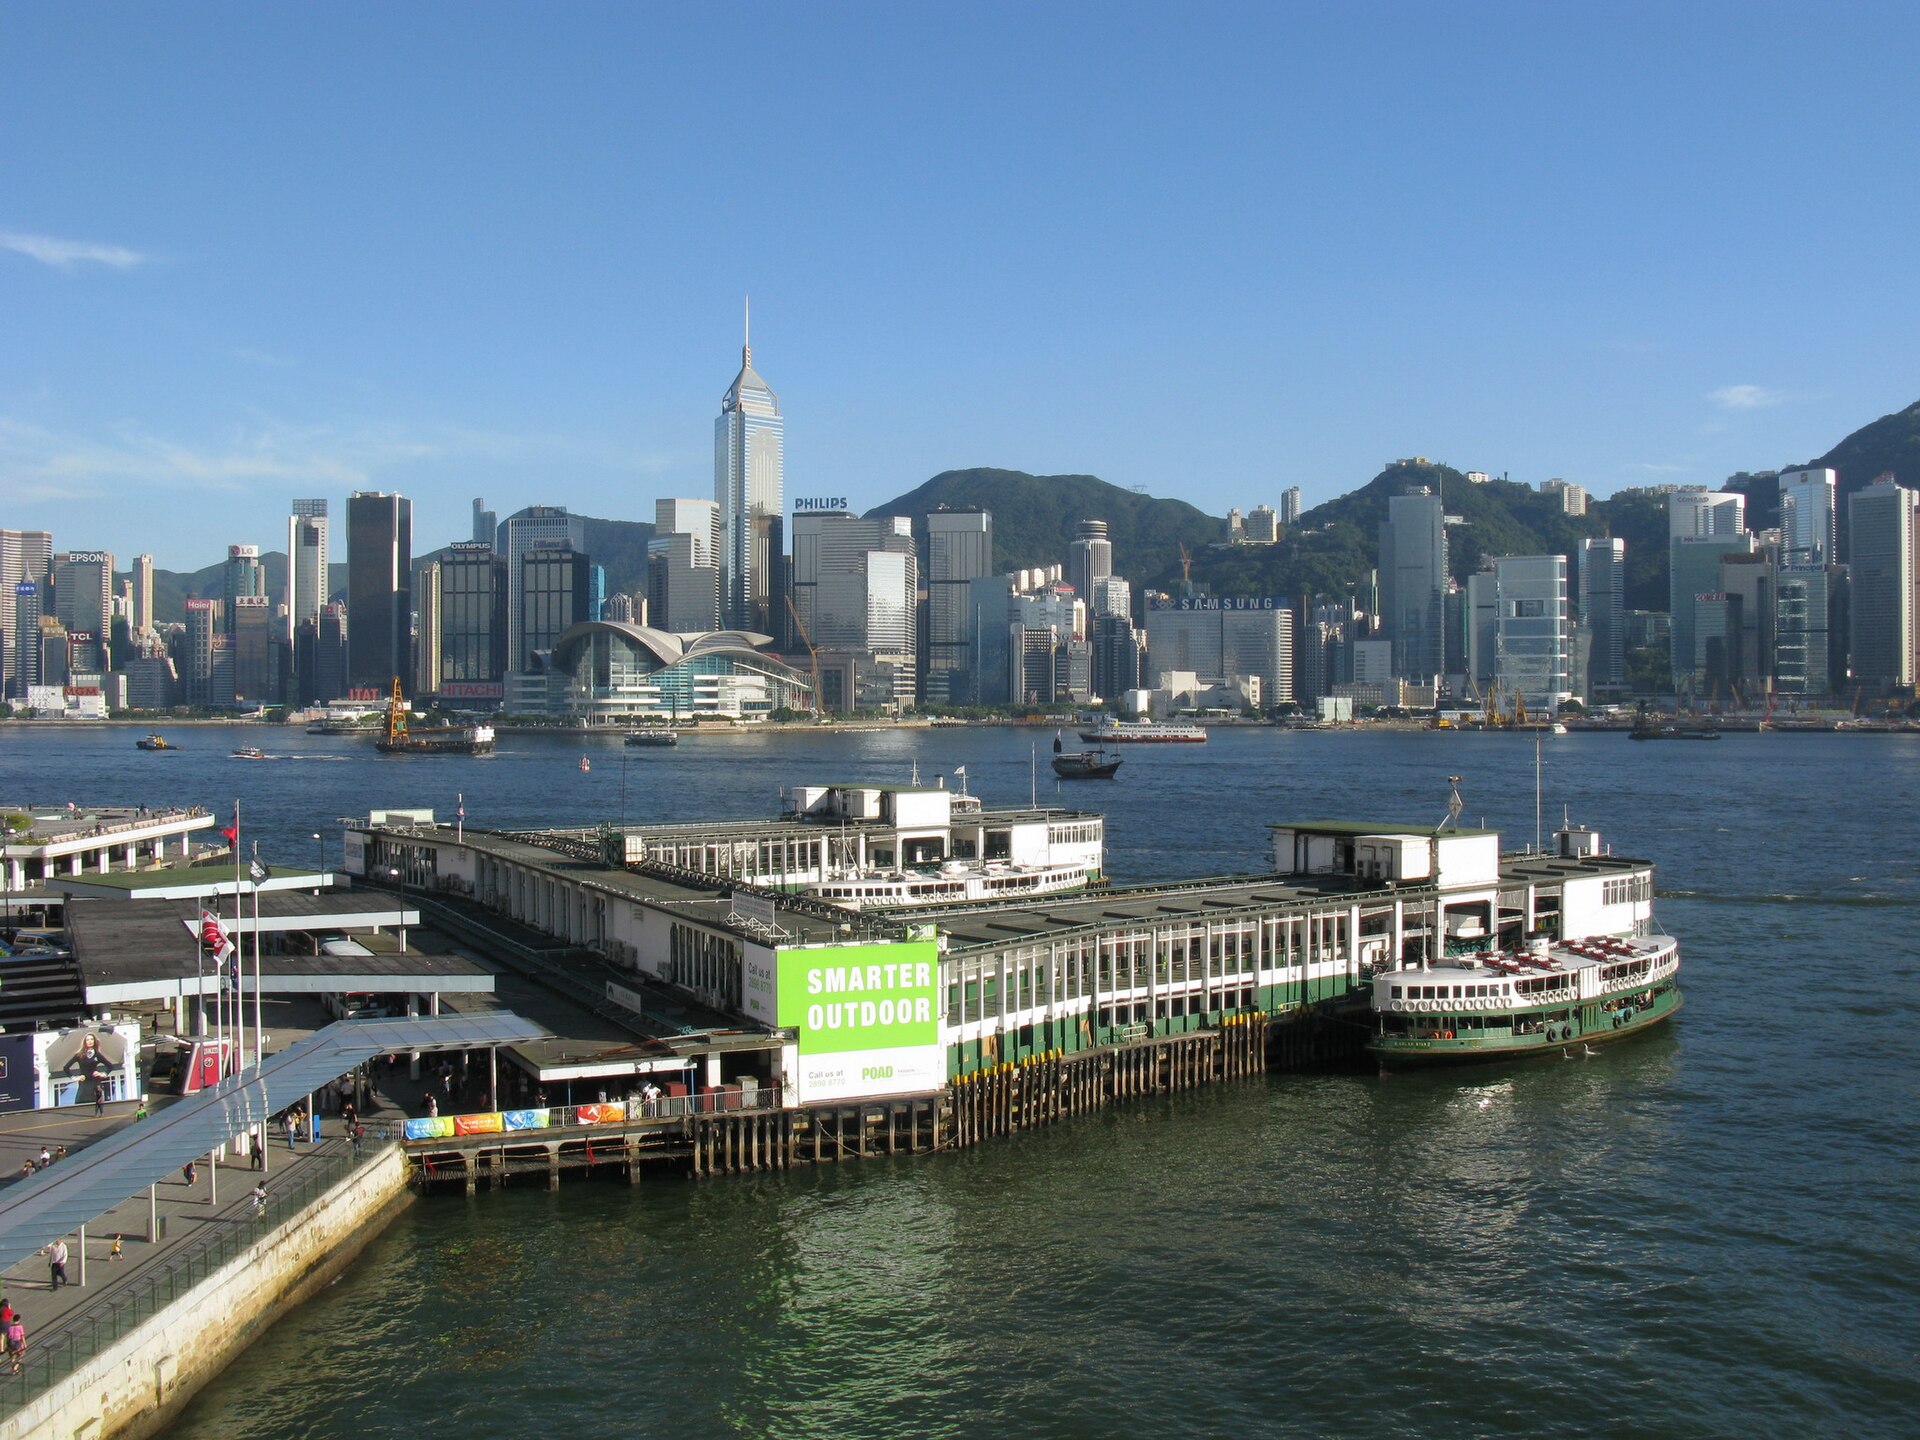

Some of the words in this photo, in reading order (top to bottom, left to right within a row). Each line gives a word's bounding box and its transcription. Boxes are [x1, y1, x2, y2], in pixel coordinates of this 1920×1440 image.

[795, 497, 848, 509] PHILIPS
[241, 547, 254, 555] LG
[69, 553, 104, 562] EPSON
[1791, 564, 1823, 572] Principal
[187, 601, 210, 609] Haier
[1182, 598, 1273, 610] SAMSUNG
[70, 633, 93, 641] TCL
[64, 686, 99, 696] MGM
[348, 688, 379, 700] ITAT
[441, 683, 502, 696] HITACHI
[748, 962, 758, 975] Call
[807, 962, 930, 994] SMARTER
[807, 997, 930, 1030] OUTDOOR
[808, 1071, 823, 1079] Call
[862, 1065, 894, 1080] POAD
